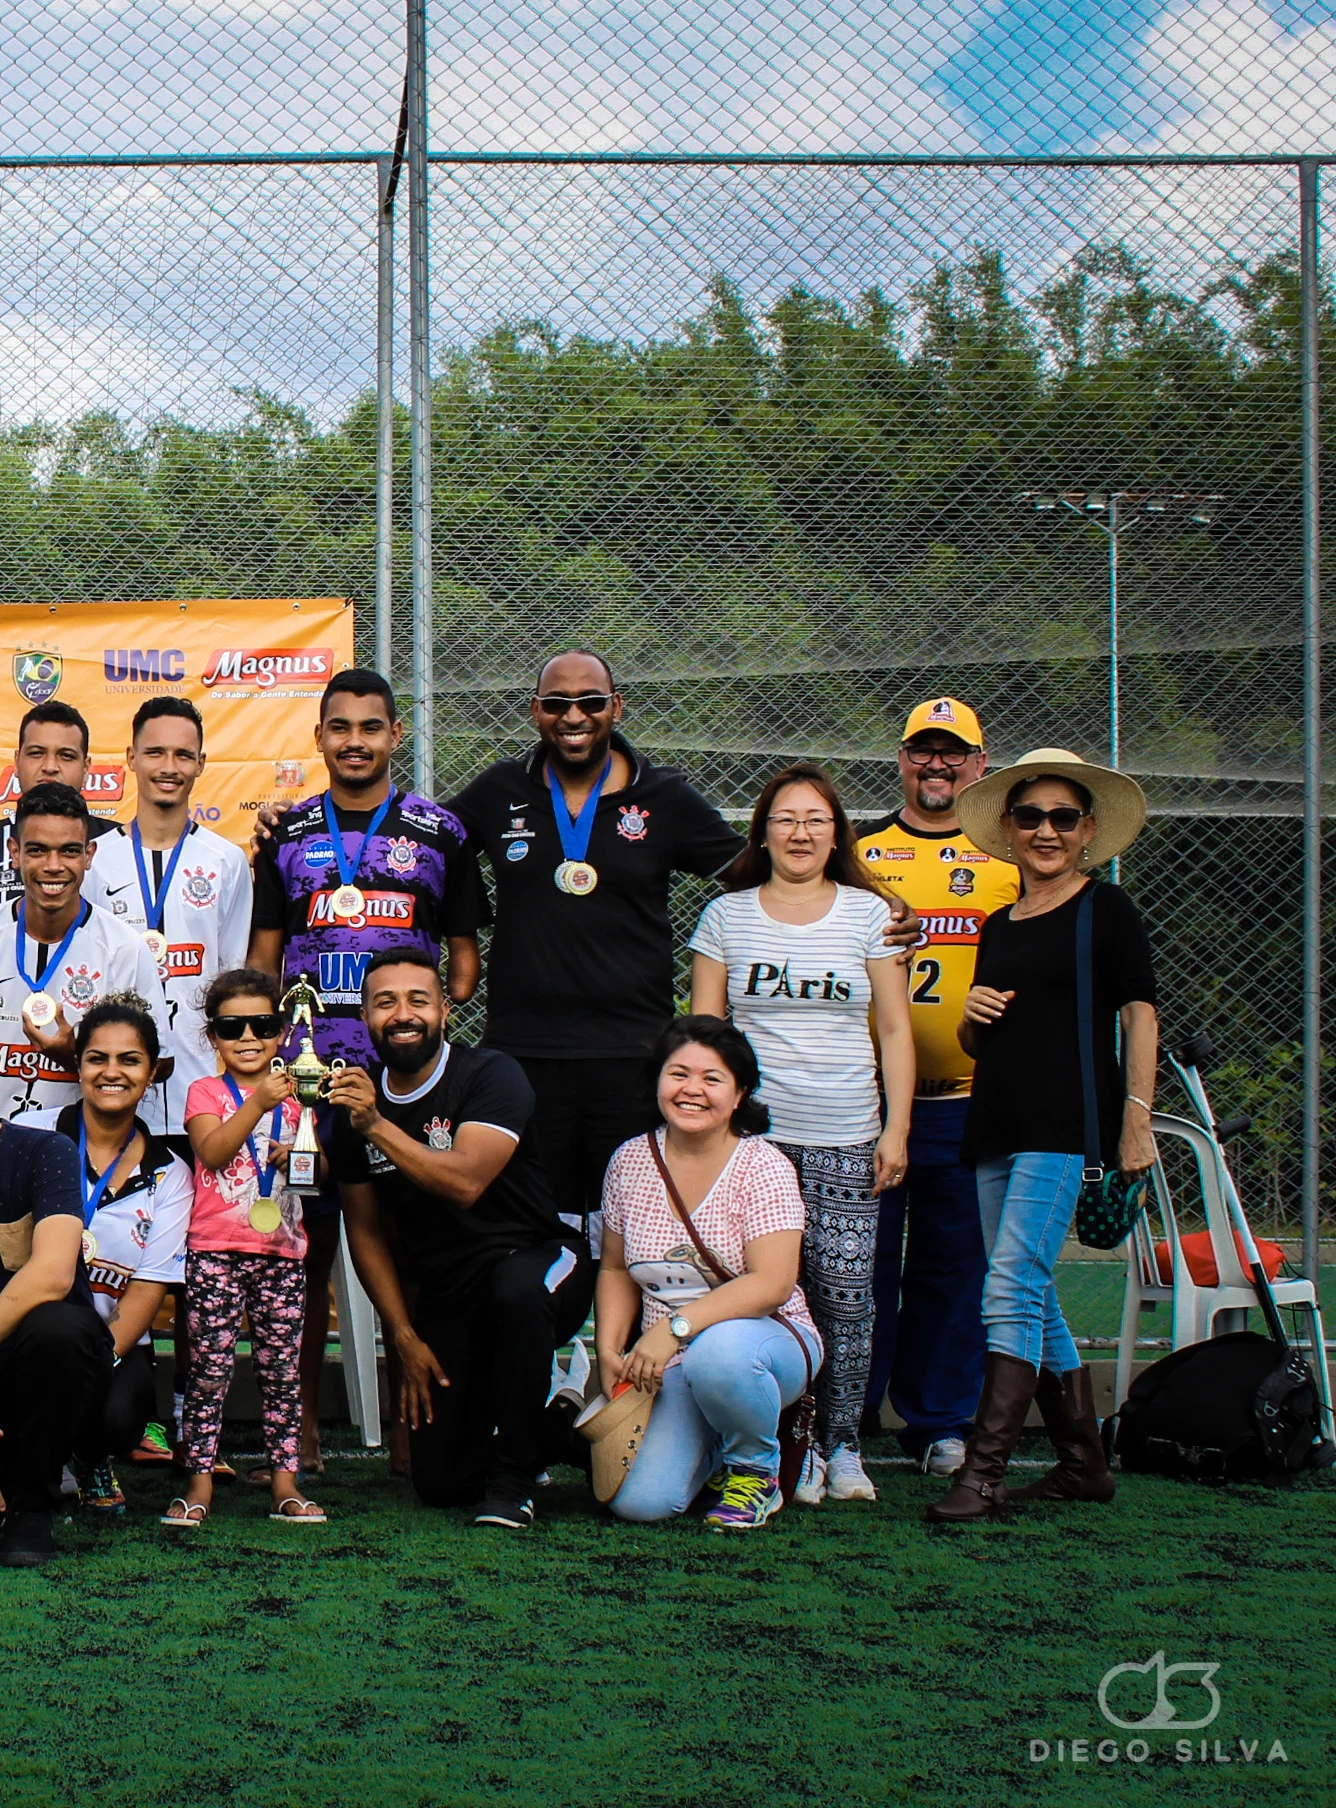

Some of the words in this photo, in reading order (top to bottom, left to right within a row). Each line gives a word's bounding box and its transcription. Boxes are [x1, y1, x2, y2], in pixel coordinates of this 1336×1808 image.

[104, 650, 186, 682] UMC
[204, 651, 328, 688] Magnus
[105, 684, 186, 694] UNIVERSIDADE
[225, 691, 251, 699] Sabor
[261, 691, 287, 699] Gente
